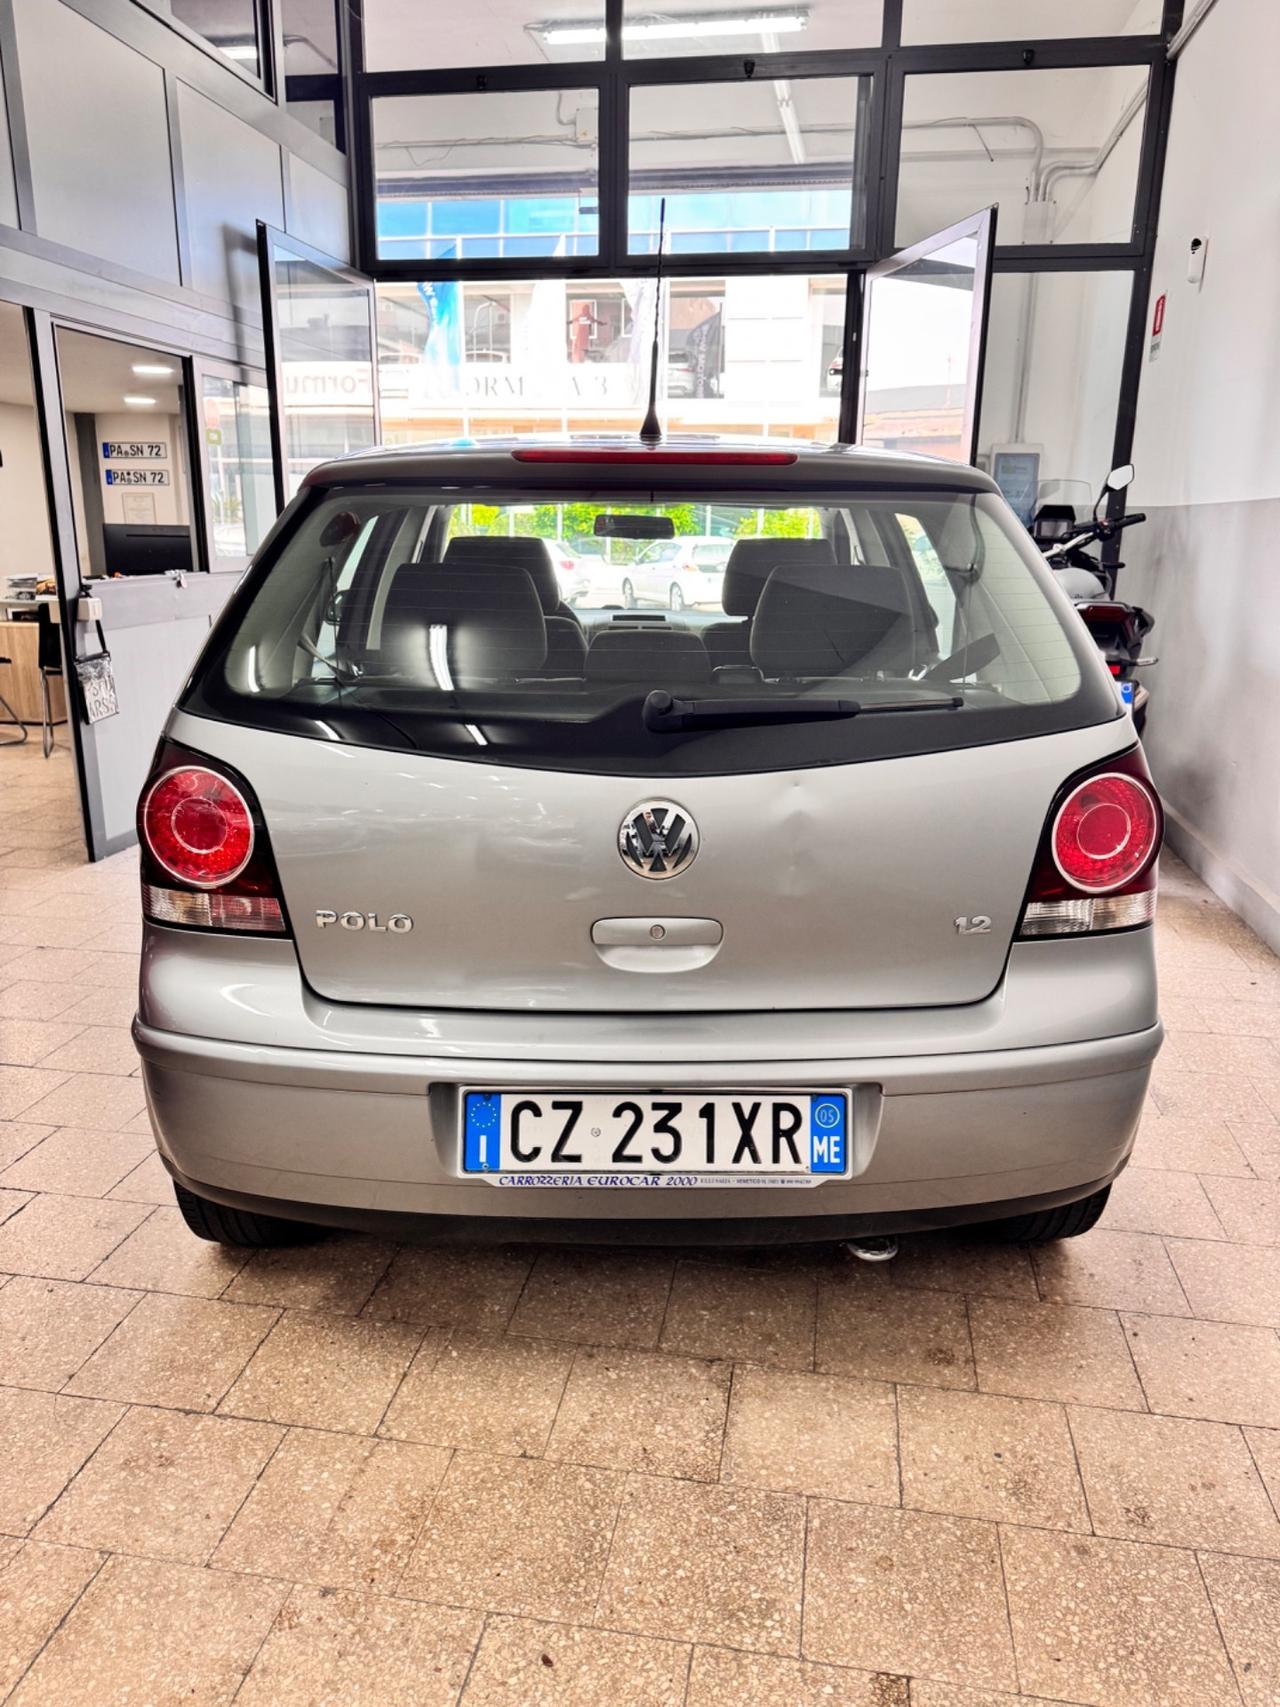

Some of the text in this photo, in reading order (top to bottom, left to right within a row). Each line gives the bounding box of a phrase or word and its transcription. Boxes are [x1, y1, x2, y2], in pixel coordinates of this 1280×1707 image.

[110, 444, 162, 457] PA SN 72
[112, 471, 164, 484] PA SN 72
[314, 908, 415, 935] POLO
[509, 1100, 584, 1165] CZ
[812, 1135, 841, 1164] ME
[498, 1175, 583, 1187] CARROZZERIA
[586, 1175, 661, 1187] EUROCAR
[665, 1175, 699, 1187] 2000
